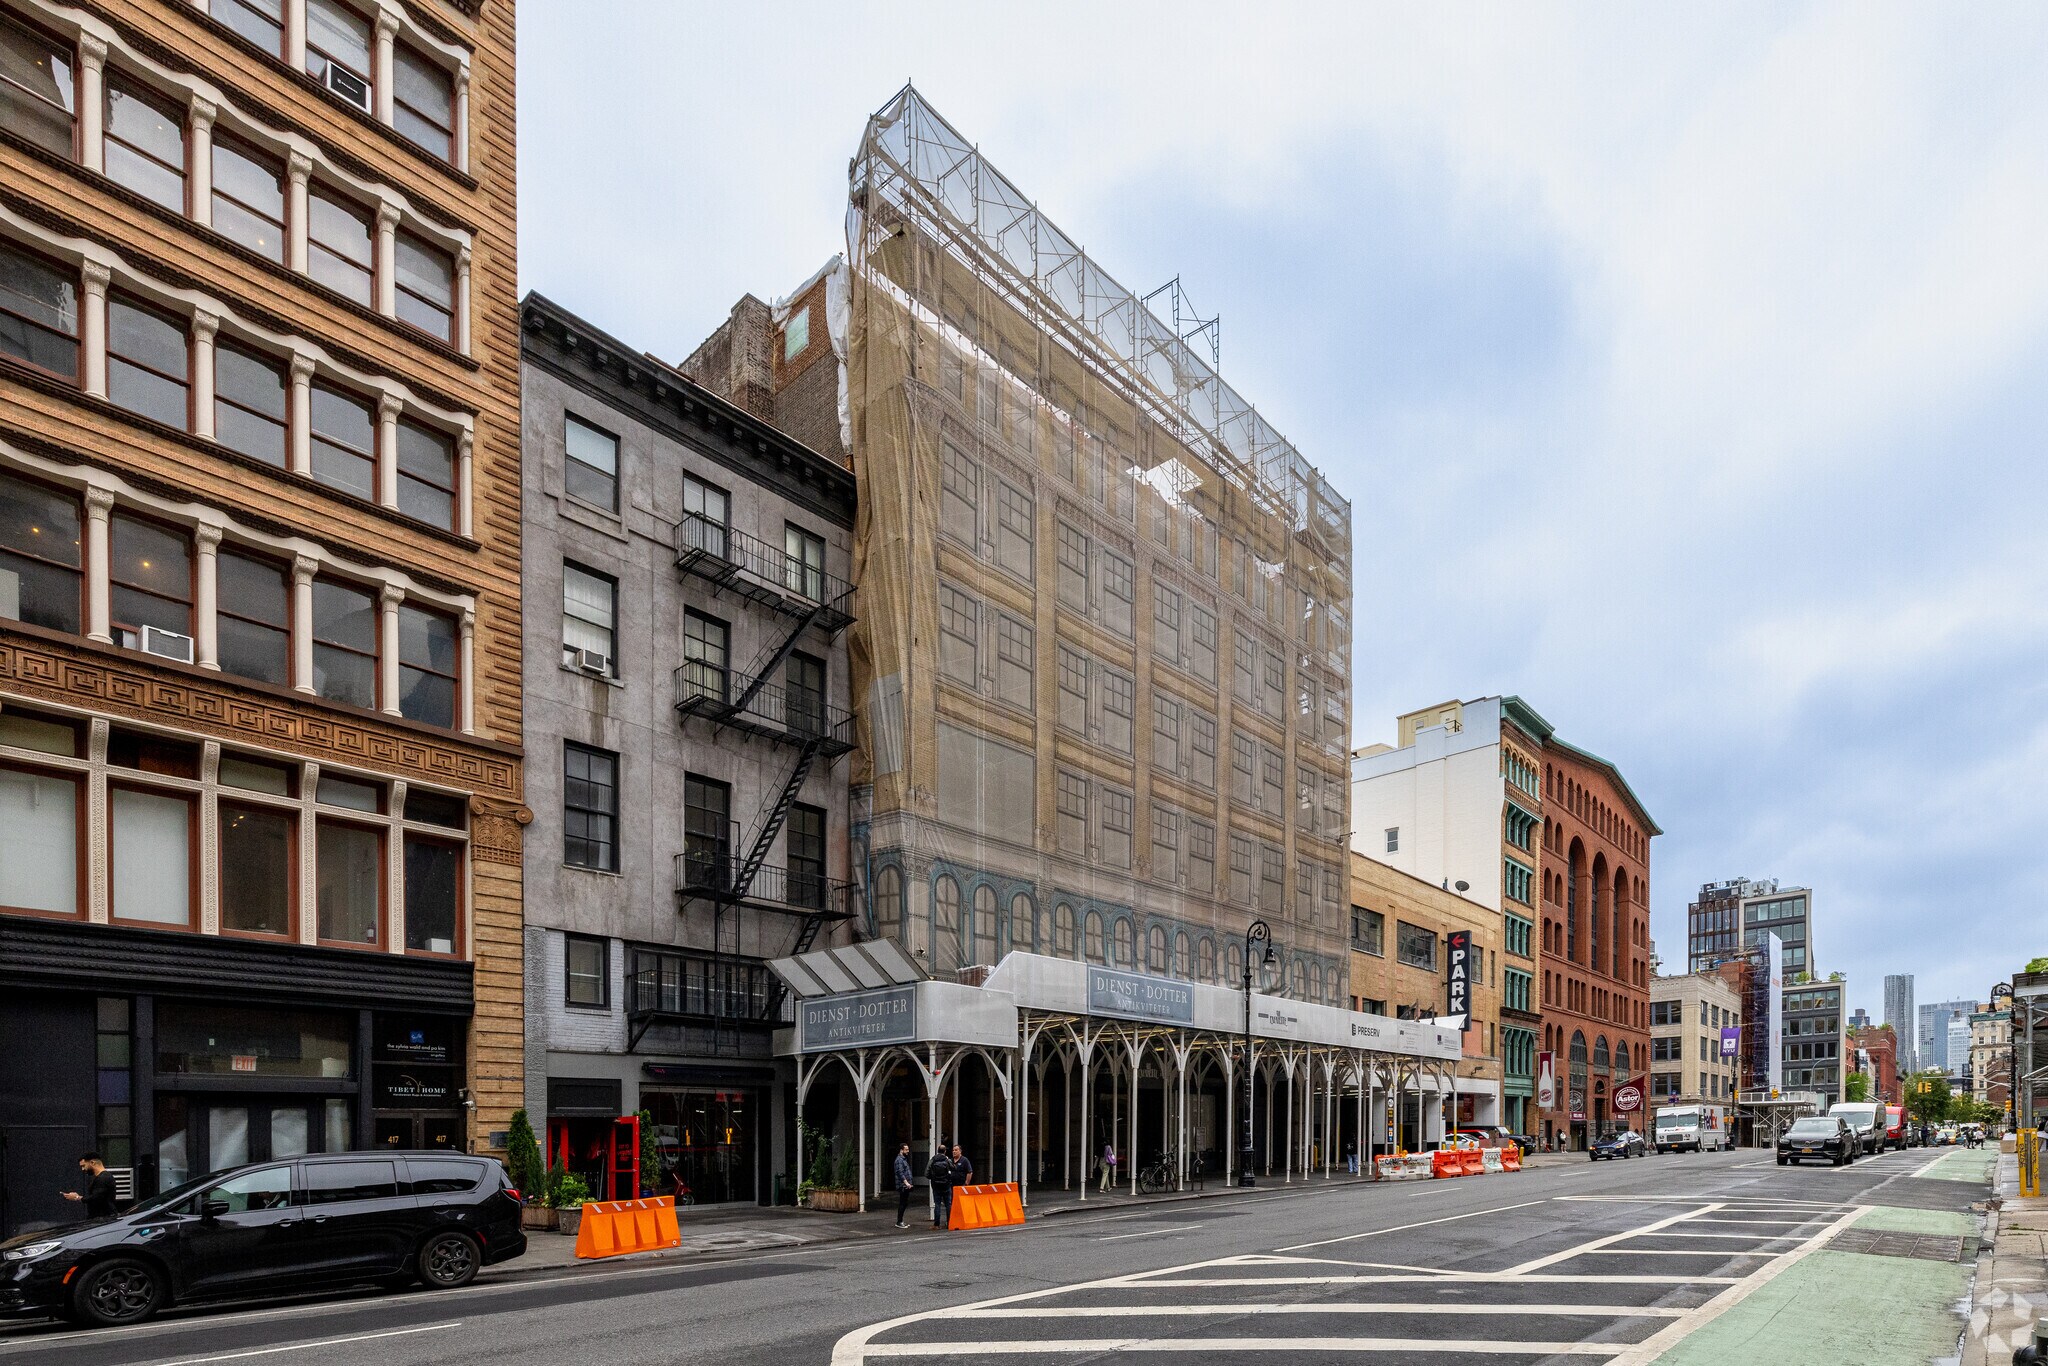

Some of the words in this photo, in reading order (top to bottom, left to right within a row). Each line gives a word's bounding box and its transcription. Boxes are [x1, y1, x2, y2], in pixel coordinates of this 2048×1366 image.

[1097, 977, 1139, 996] DIENST
[1147, 985, 1187, 1004] DOTTER
[809, 1006, 851, 1025] DIENST
[859, 998, 907, 1018] DOTTER
[1116, 999, 1170, 1015] ANTIKVITETER
[828, 1022, 886, 1038] ANTIKVITETER
[235, 1056, 254, 1070] EXIT
[1618, 1094, 1639, 1103] Astor
[387, 1135, 399, 1144] 417
[435, 1135, 447, 1143] 417
